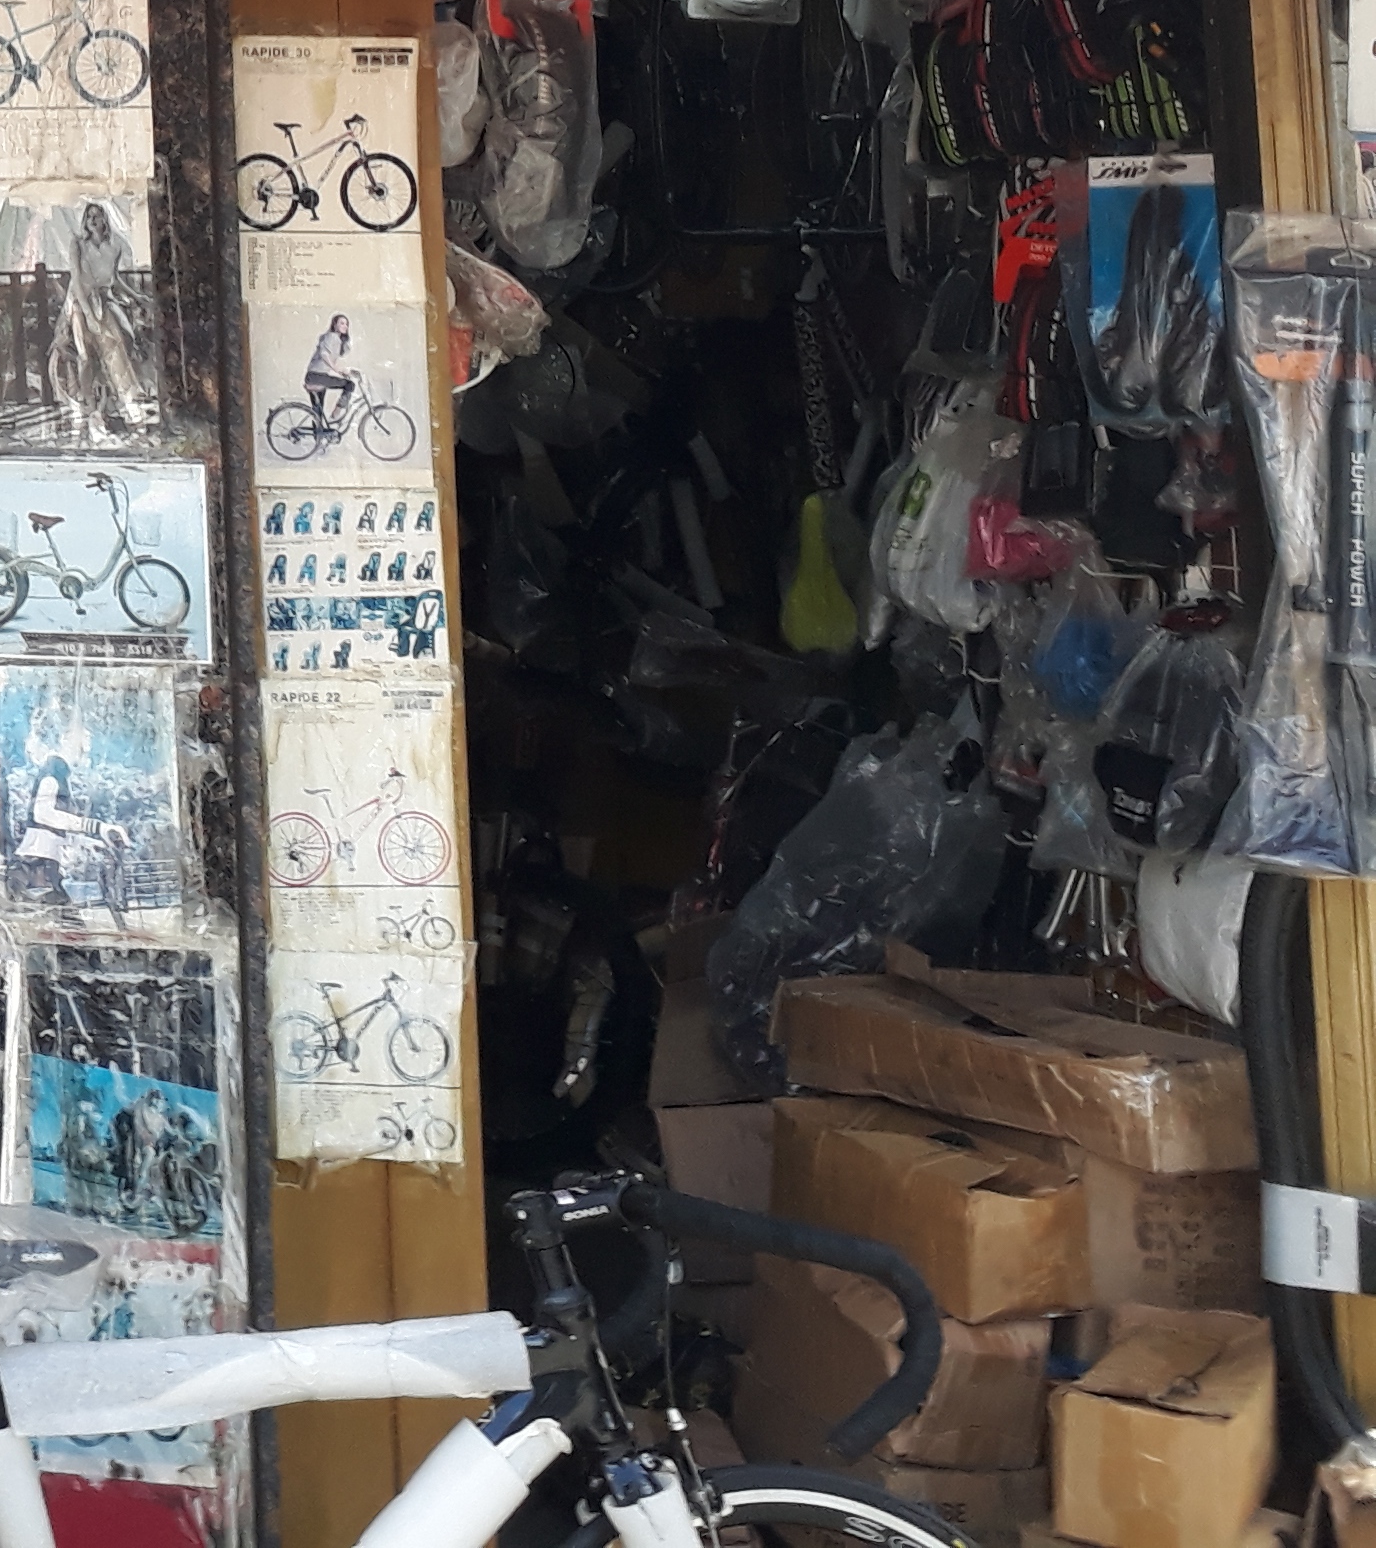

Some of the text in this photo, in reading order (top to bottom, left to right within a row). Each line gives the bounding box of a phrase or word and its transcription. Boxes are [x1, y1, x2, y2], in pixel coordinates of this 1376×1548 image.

[241, 46, 289, 58] RAPIDE
[271, 692, 341, 703] RAPIDE 22
